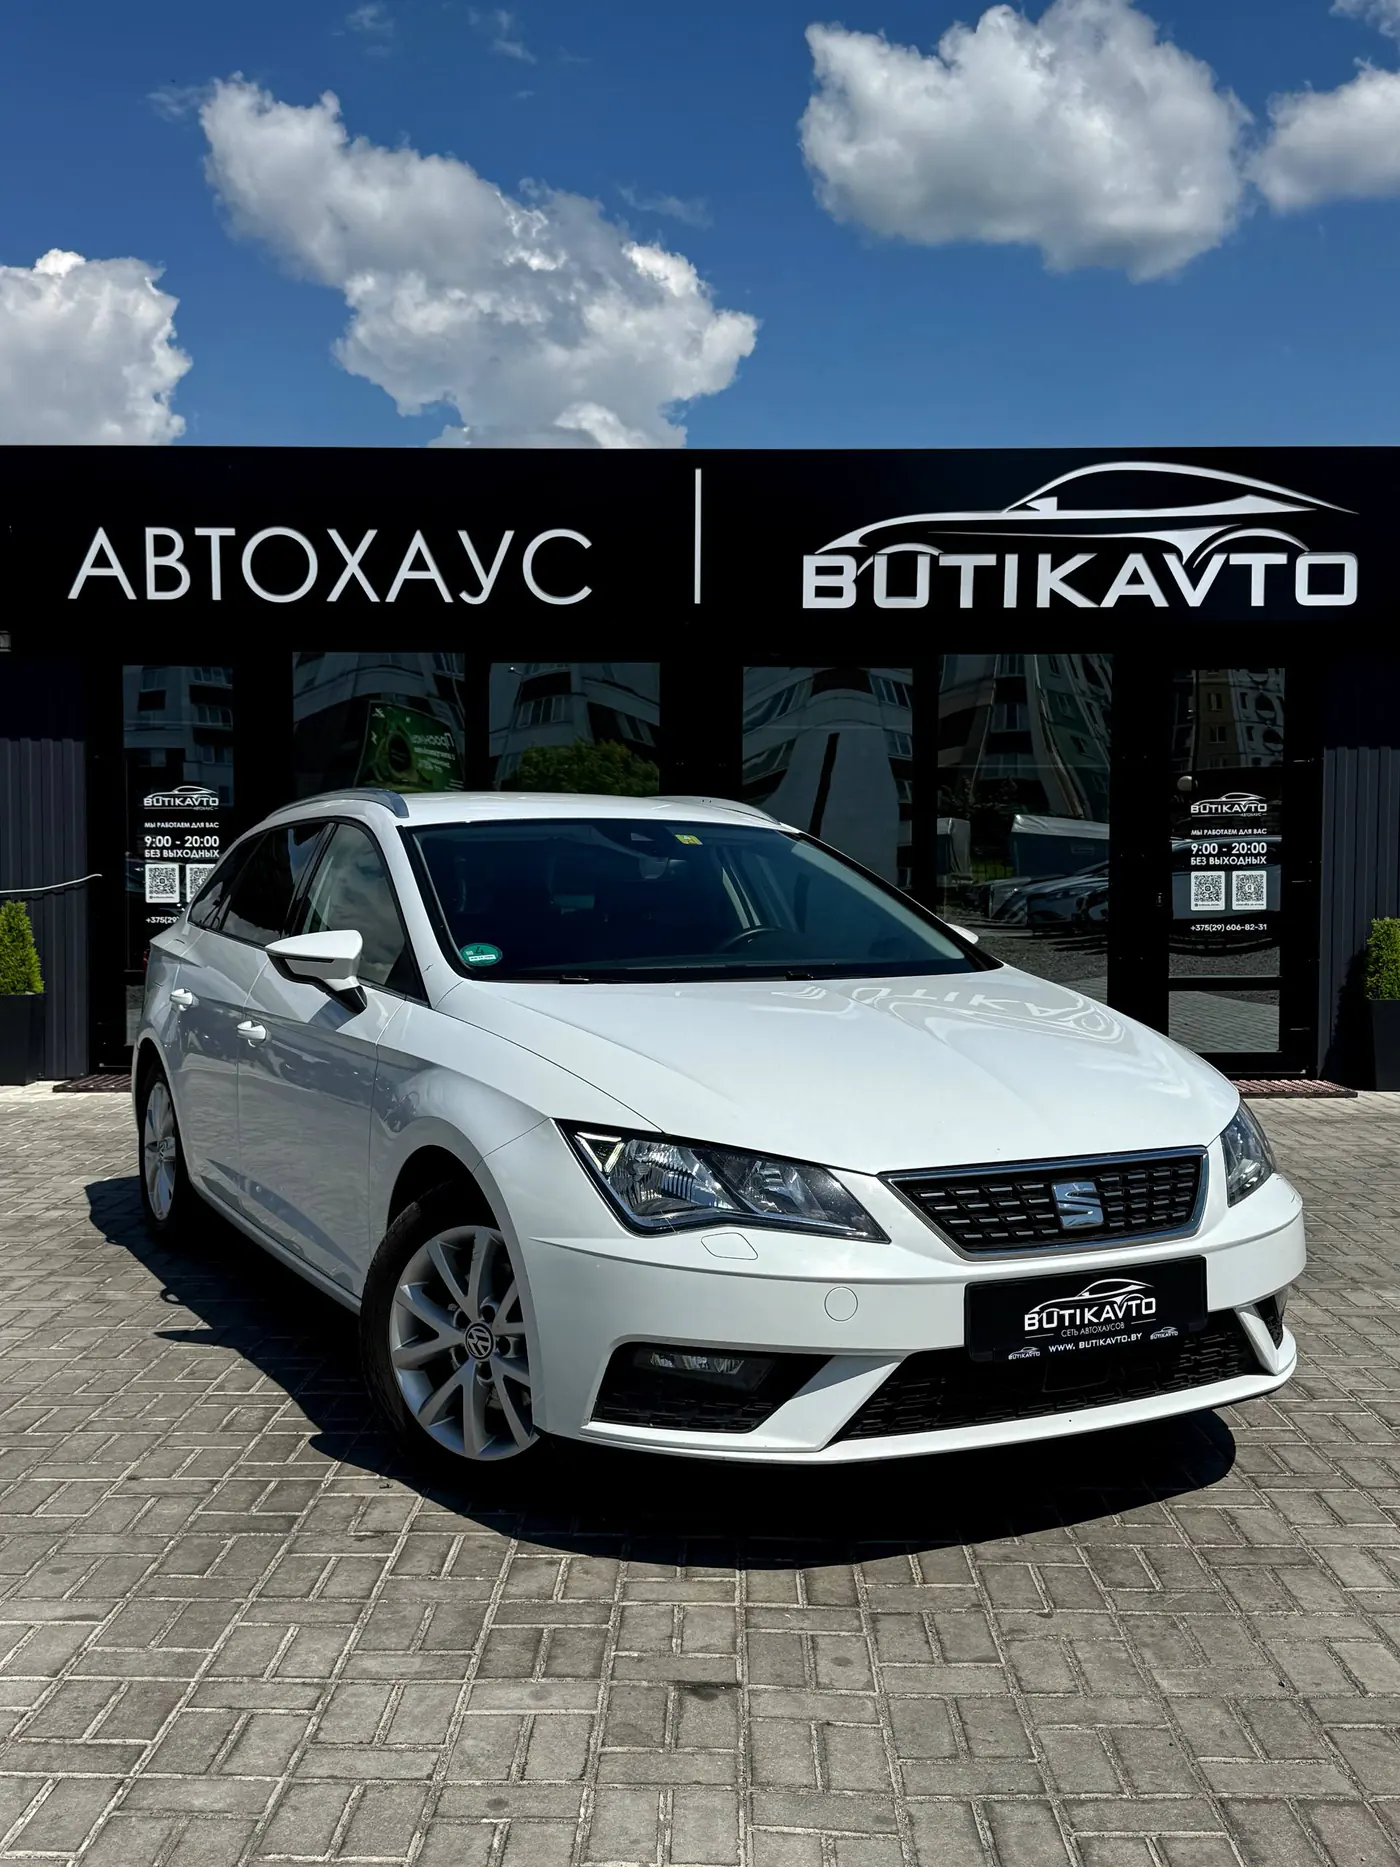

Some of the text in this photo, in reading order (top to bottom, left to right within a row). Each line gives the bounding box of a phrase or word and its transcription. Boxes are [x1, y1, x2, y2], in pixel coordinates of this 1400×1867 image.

[68, 527, 593, 605] АВТОХАУС
[802, 552, 1358, 609] BUTIKAVTO
[144, 798, 219, 806] BUTIKAVTO
[1190, 804, 1267, 813] BUTIKAVTO
[144, 836, 172, 847] 9:00
[184, 836, 220, 847] 20:00
[1191, 843, 1218, 854] 9:00
[1231, 842, 1267, 853] 20:00
[144, 849, 220, 859] БЕЗ ВЫХОДНЫХ
[1190, 856, 1267, 865] БЕЗ ВЫХОДНЫХ
[145, 916, 180, 924] +375(29
[1190, 923, 1267, 932] +375(29) 606-82-31
[1024, 1297, 1156, 1330] BUTIKAVTO
[1060, 1322, 1125, 1337] СЕТЬ АВТОХАУСОВ
[1150, 1330, 1179, 1340] BUTIKAVTO
[1078, 1332, 1143, 1349] BUTIKAVTO.BY
[1008, 1351, 1041, 1360] BUTIKAVTO
